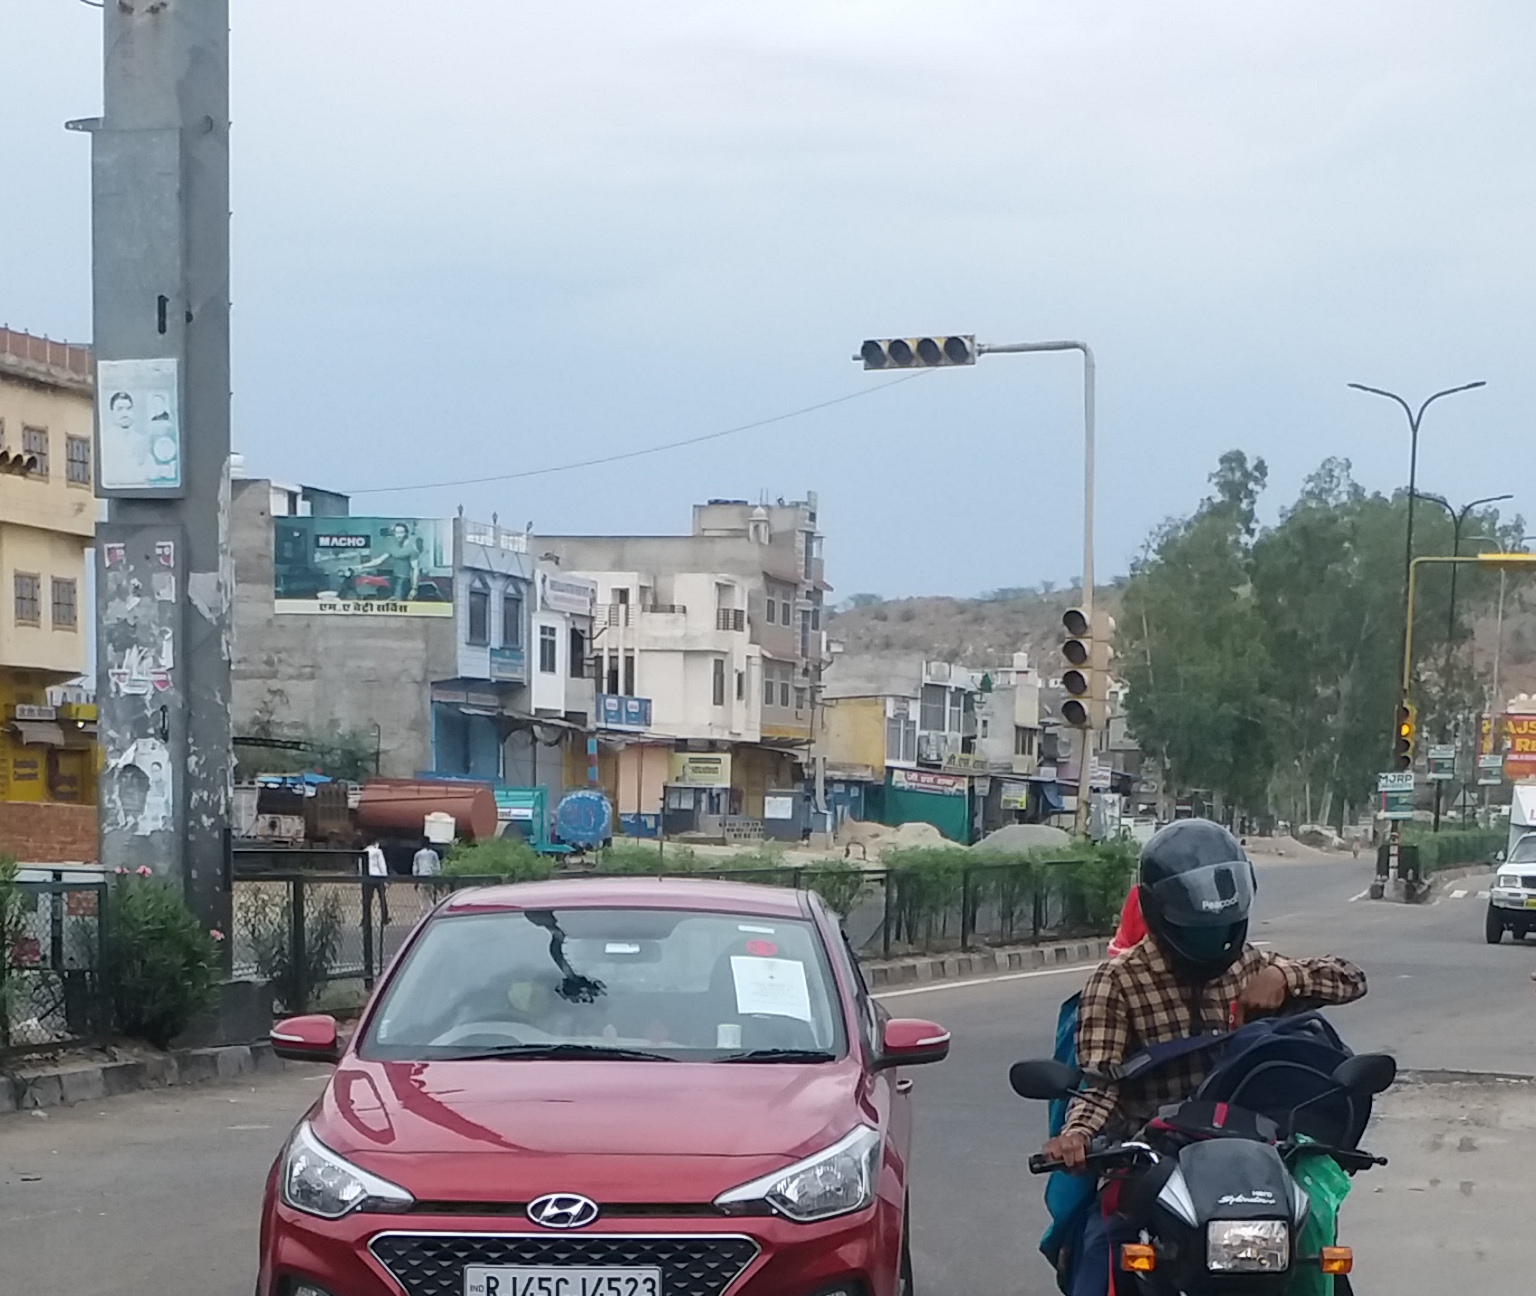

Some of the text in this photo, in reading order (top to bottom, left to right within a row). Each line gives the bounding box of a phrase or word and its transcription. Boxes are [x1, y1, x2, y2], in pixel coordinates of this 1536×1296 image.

[318, 536, 366, 547] MACHO
[1379, 774, 1413, 783] MJRP
[470, 1284, 485, 1293] IND
